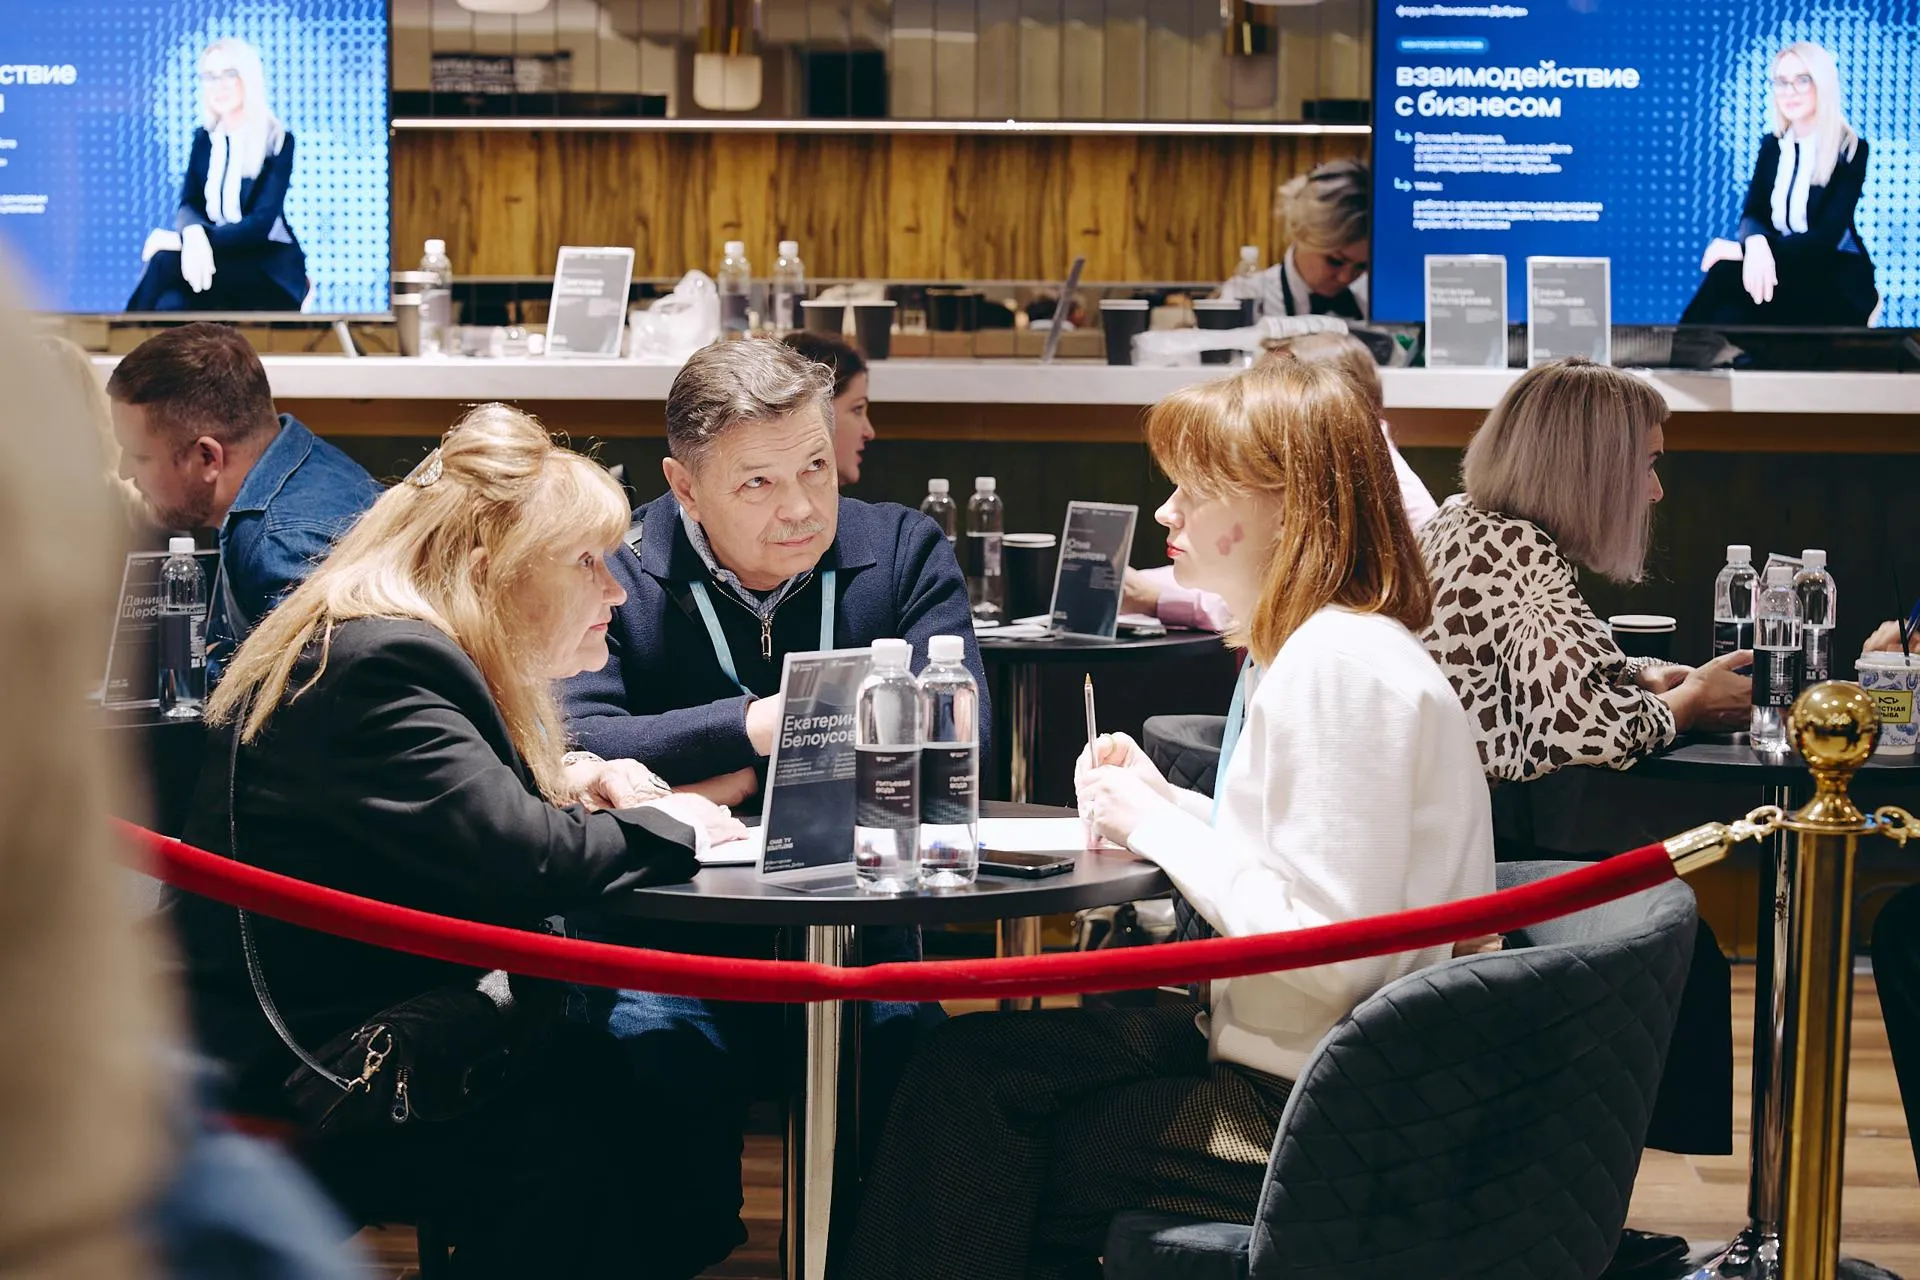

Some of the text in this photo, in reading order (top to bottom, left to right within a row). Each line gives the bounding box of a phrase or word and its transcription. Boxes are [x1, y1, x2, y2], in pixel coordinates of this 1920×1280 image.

[0, 64, 77, 85] ствие
[1396, 60, 1640, 91] взаимодействие
[1395, 90, 1561, 117] с бизнесом
[122, 604, 163, 619] Щерб
[784, 714, 857, 731] Екатерин
[781, 730, 857, 749] Белоусов
